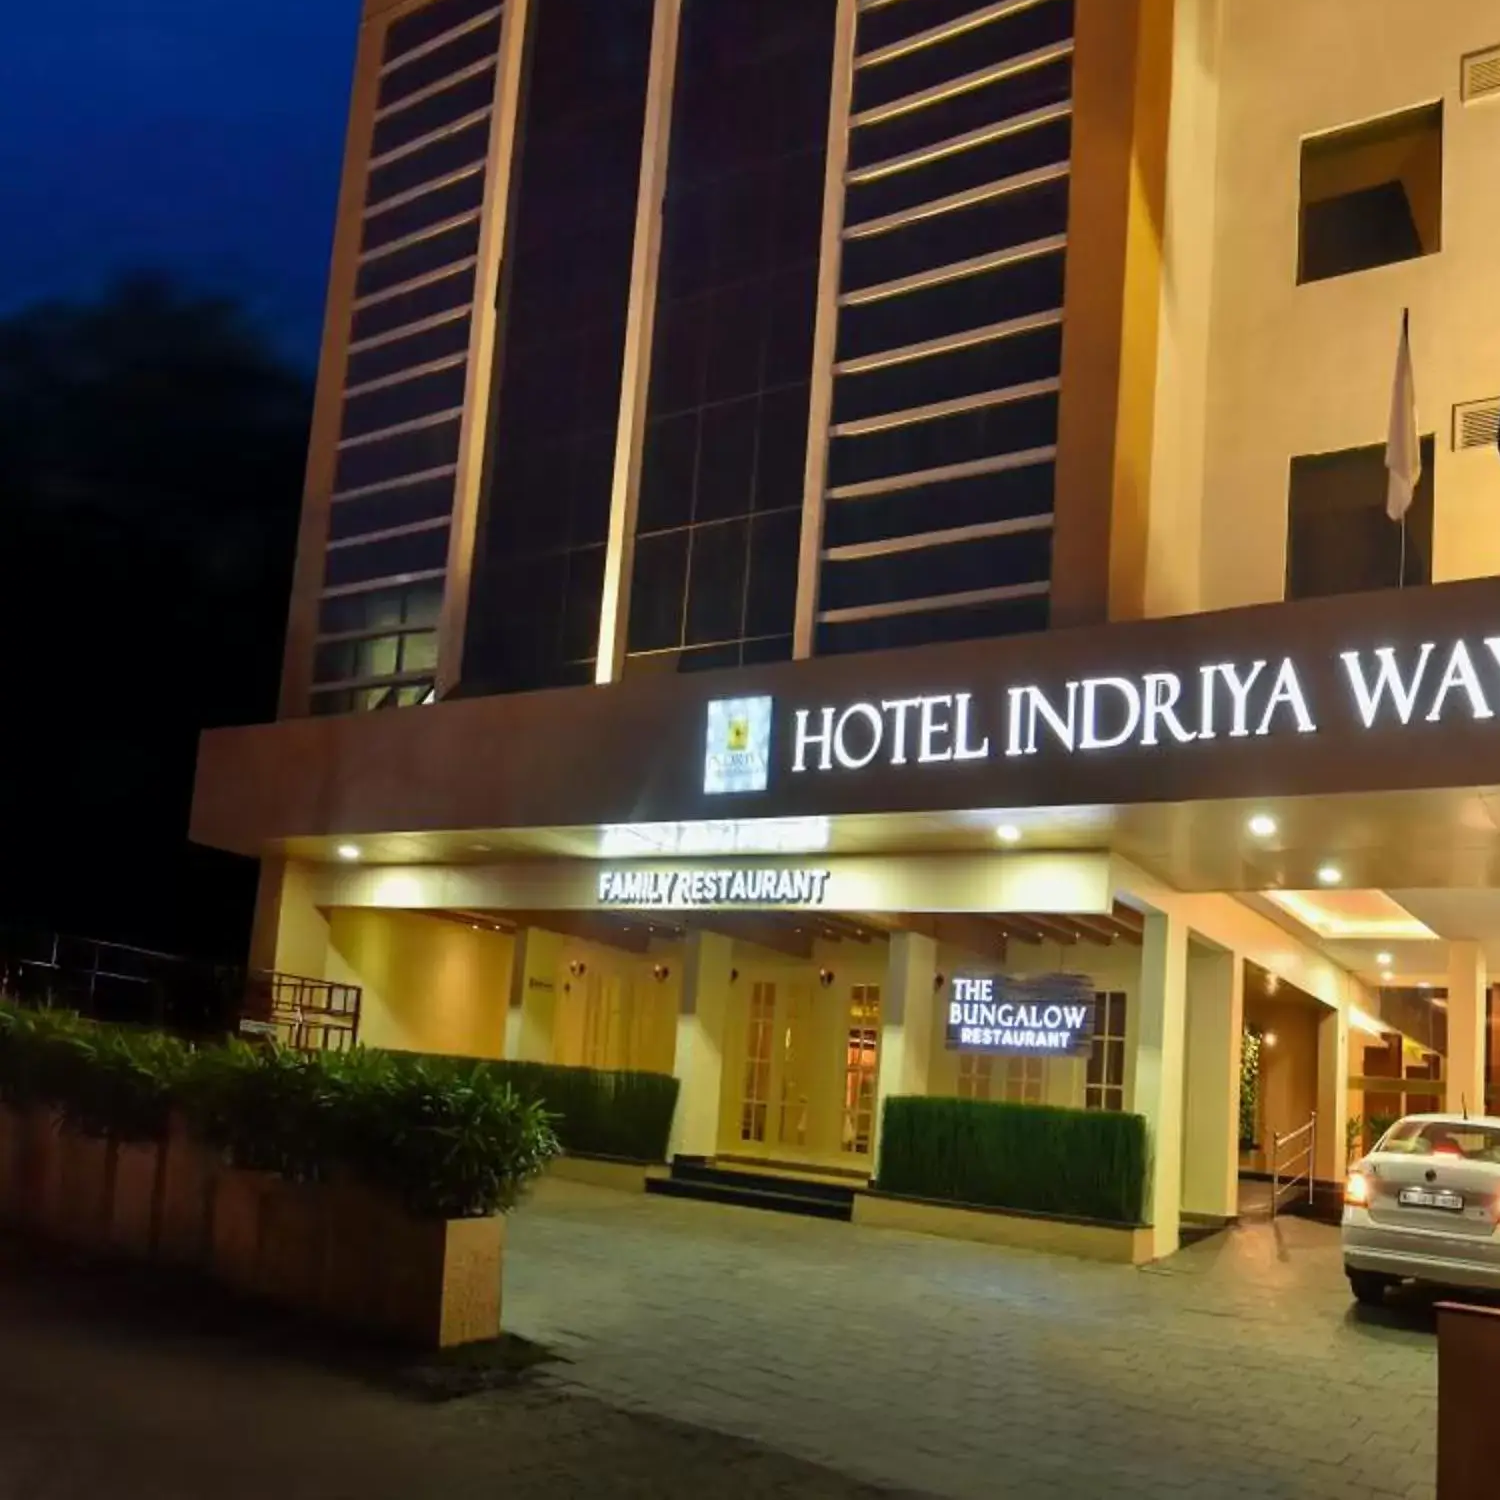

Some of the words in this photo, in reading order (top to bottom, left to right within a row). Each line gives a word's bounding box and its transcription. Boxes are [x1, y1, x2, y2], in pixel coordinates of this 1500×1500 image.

[792, 692, 988, 771] HOTEL
[1005, 656, 1317, 757] INDRIYA
[599, 871, 676, 903] FAMILY
[677, 869, 829, 903] RESTAURANT
[952, 978, 993, 1001] THE
[949, 1002, 1086, 1029] BUNGALOW
[961, 1028, 1070, 1048] RESTAURANT
